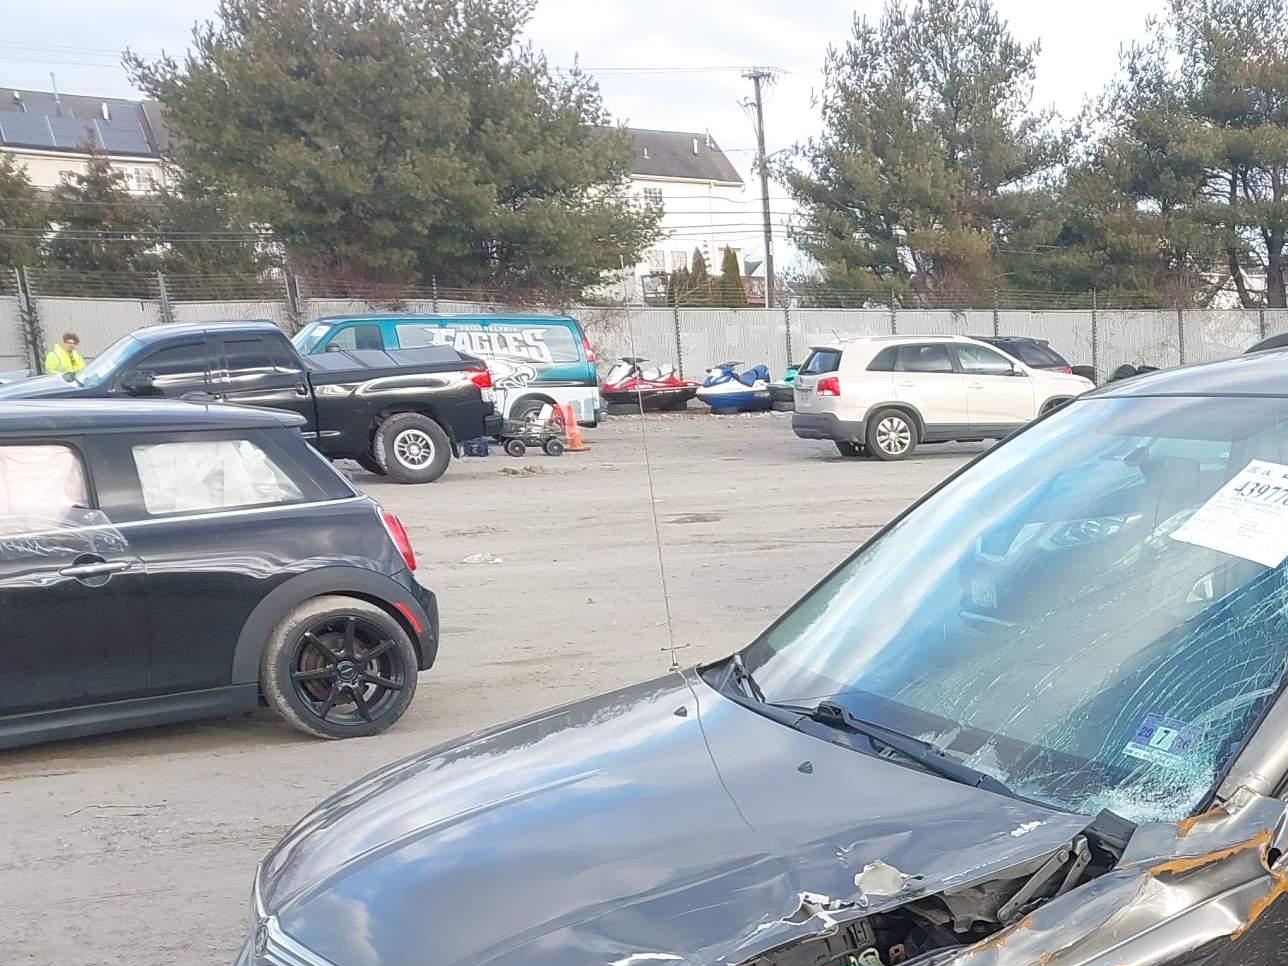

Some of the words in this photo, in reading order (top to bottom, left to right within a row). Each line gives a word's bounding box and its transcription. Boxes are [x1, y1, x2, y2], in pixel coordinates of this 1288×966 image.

[424, 327, 554, 363] EAGLES
[1138, 726, 1154, 738] 20
[1156, 730, 1171, 745] 7
